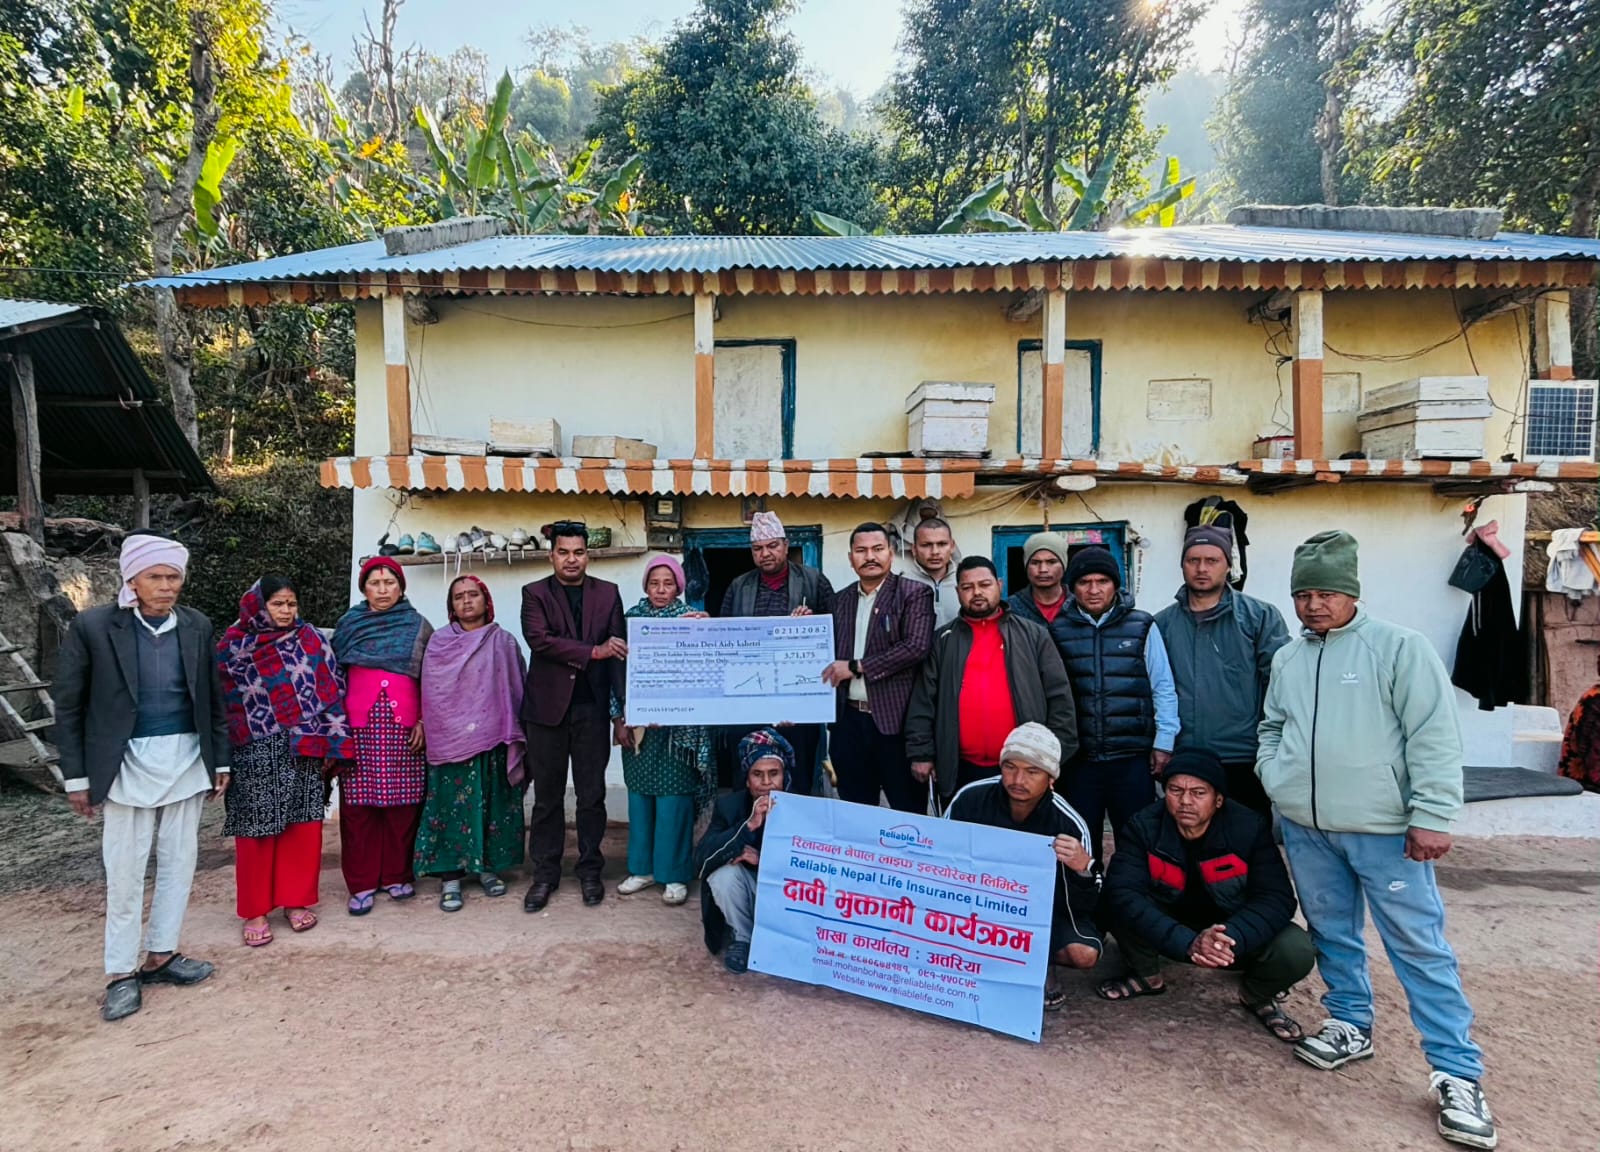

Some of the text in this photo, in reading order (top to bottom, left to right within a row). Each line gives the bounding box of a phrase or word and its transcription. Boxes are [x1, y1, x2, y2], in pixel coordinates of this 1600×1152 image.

[784, 651, 815, 660] 3,71,175
[880, 829, 915, 842] Reliable
[917, 836, 934, 846] Life
[790, 857, 1028, 917] Reliable Nepal Life Insurance Limited
[845, 845, 875, 862] नेपाल
[879, 856, 913, 869] लाइफ
[981, 873, 1029, 894] लिमिटेड
[783, 878, 1034, 953] दावी भुक्तानी कार्यक्रम
[816, 926, 848, 945] शाखा
[853, 937, 911, 958] कार्यालय
